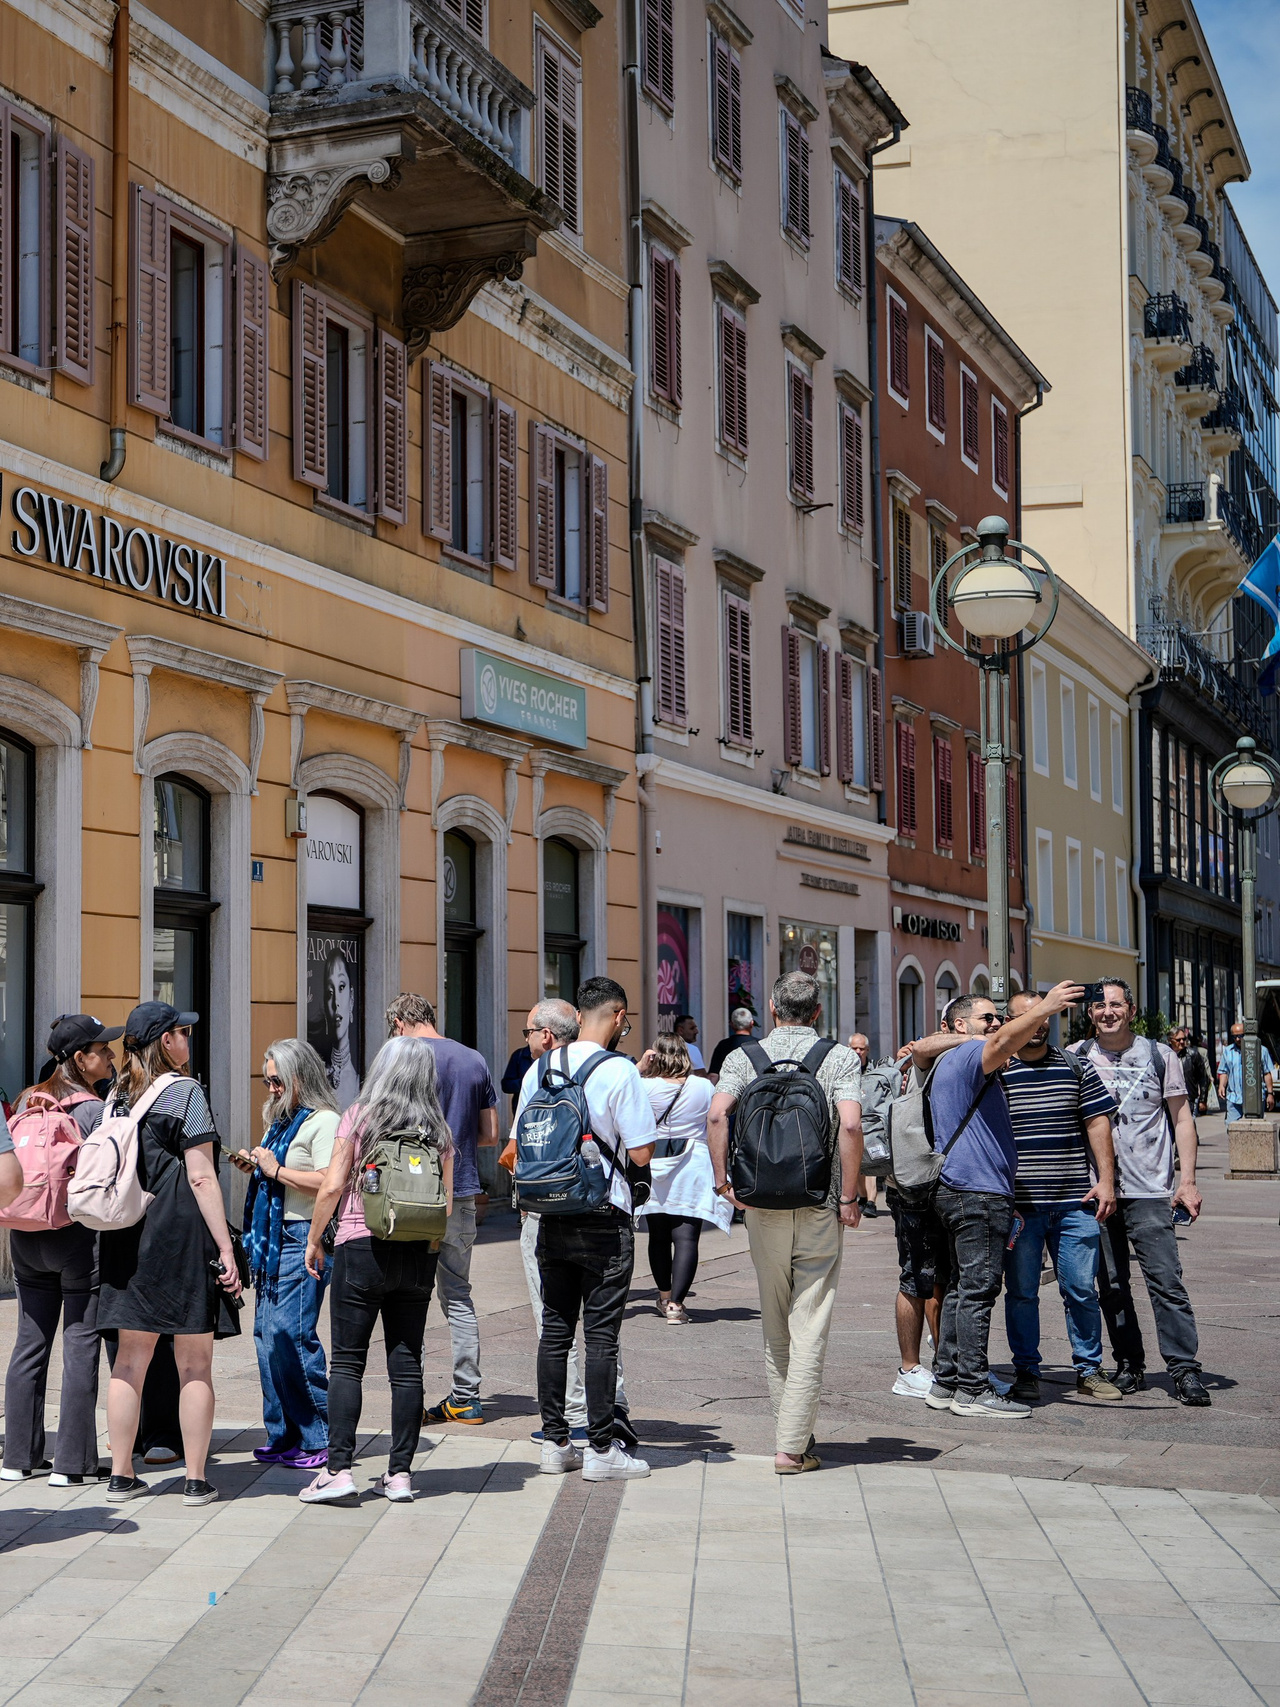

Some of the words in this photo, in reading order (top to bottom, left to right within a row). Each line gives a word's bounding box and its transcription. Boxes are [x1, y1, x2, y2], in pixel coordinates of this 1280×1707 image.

[11, 487, 228, 618] SWAROVSKI
[499, 675, 527, 706] YVES
[530, 686, 578, 721] ROCHER
[520, 710, 558, 731] FRANCE
[307, 937, 357, 963] AROSKI
